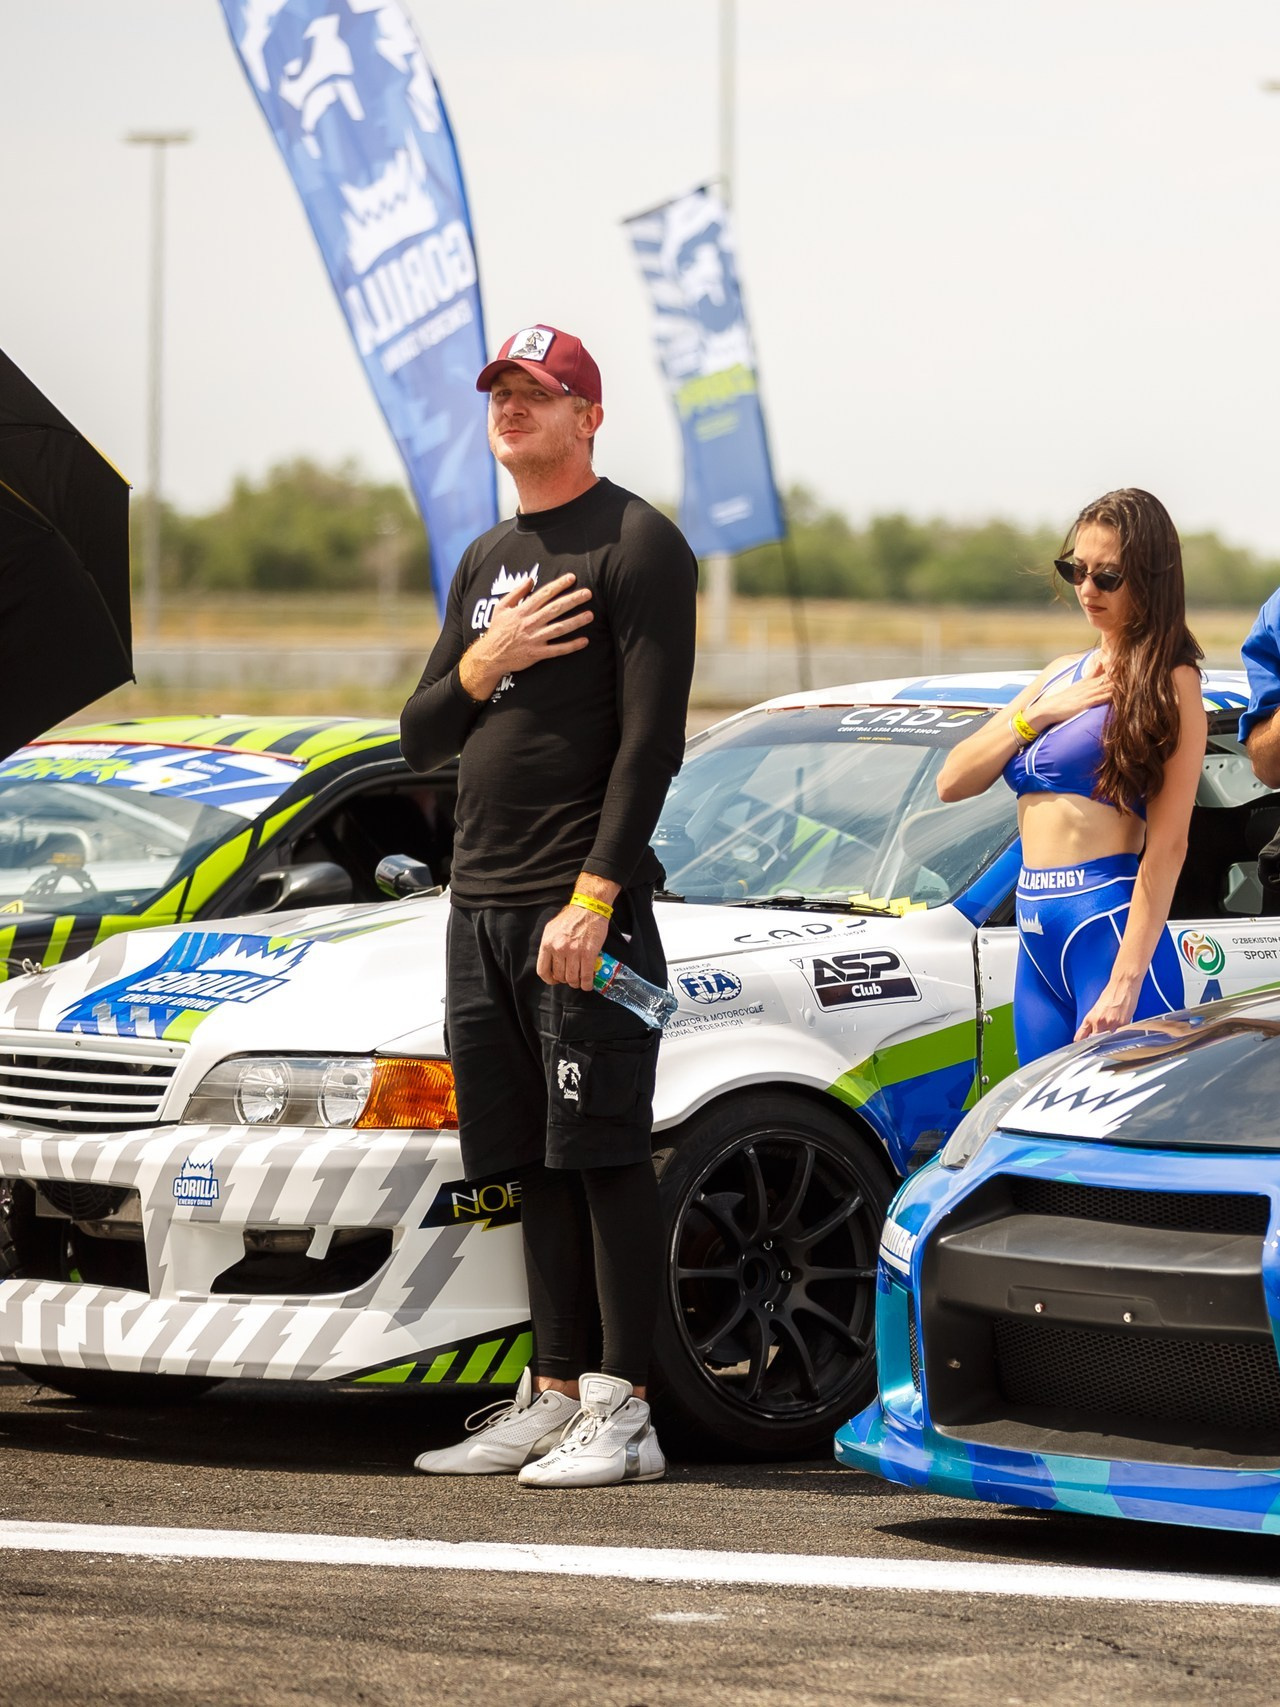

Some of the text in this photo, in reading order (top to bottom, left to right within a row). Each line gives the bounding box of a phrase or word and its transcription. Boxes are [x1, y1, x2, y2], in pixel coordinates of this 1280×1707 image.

[1244, 950, 1278, 960] SPORT
[812, 951, 901, 986] ASP
[126, 971, 286, 1002] GORILLA
[851, 984, 882, 998] Club
[117, 993, 220, 1011] ENERGY DRINK
[673, 1015, 701, 1029] MOTOR
[710, 1005, 765, 1020] MOTORCYCLE
[694, 1019, 744, 1032] FEDERATION
[173, 1179, 218, 1198] GORILLA
